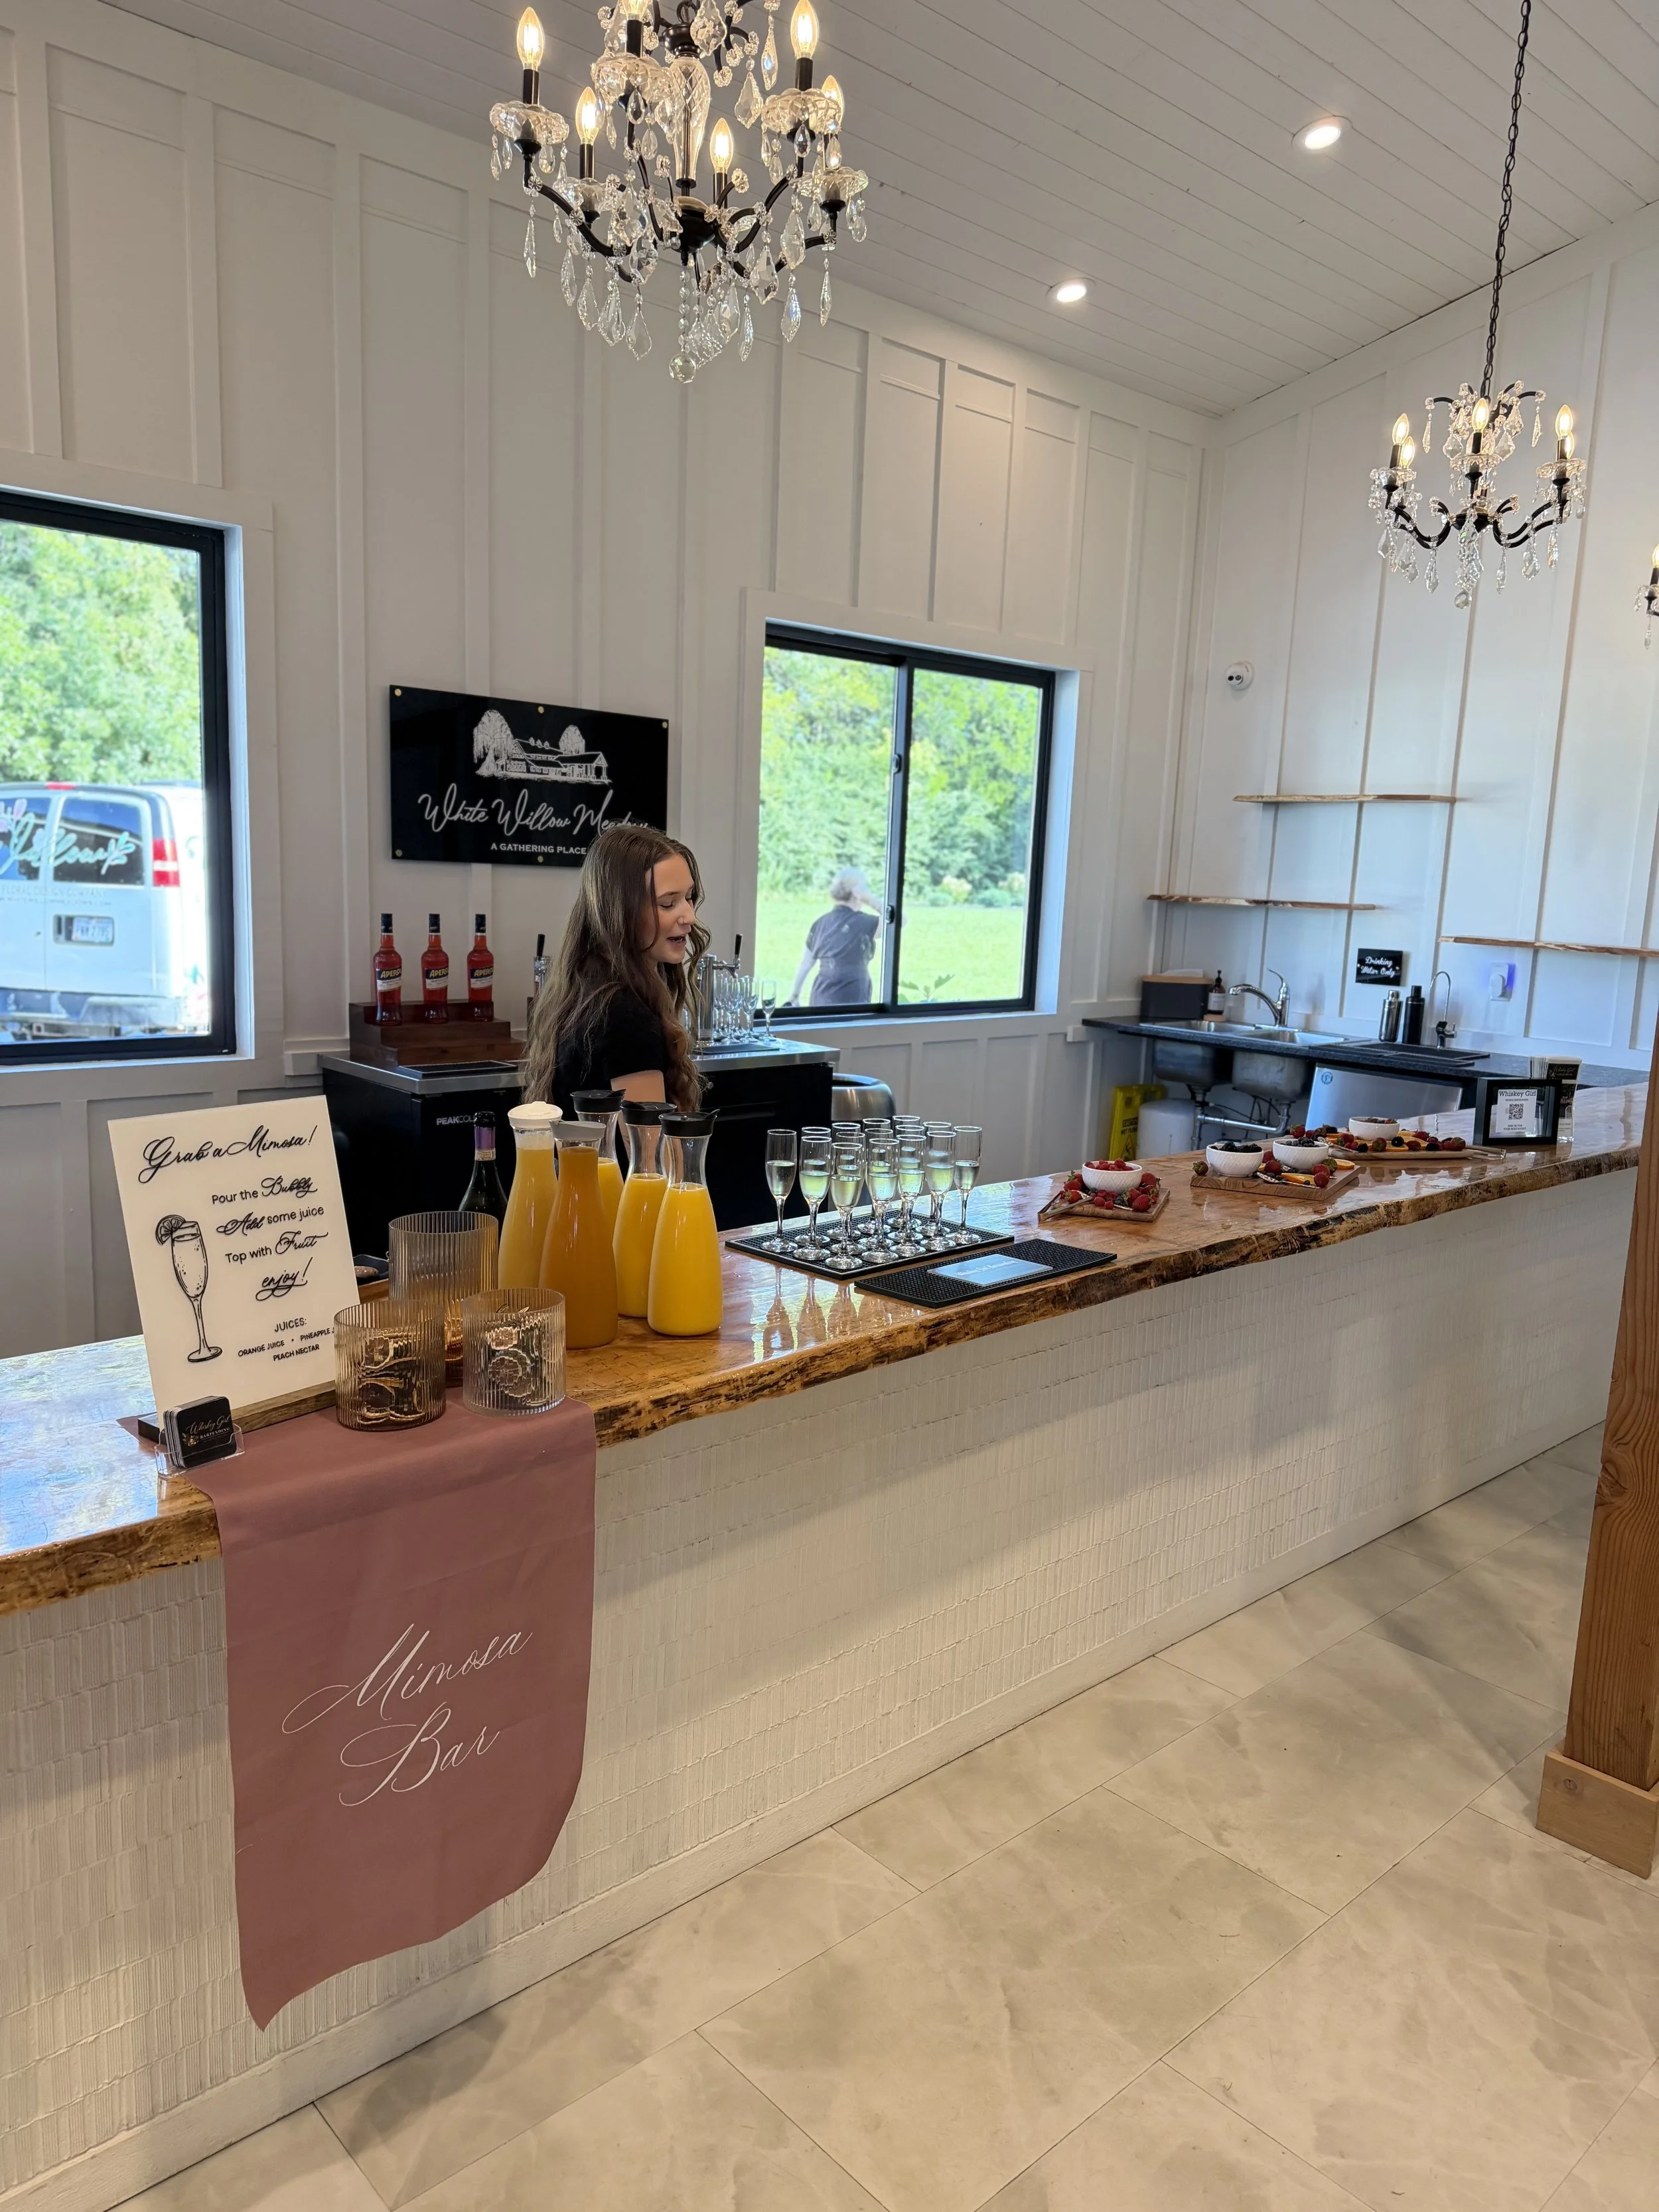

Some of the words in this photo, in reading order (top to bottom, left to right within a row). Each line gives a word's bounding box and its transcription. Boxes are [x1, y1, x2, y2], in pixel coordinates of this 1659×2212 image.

[417, 782, 489, 833] White
[491, 788, 571, 836] Willow
[500, 844, 554, 853] GATHERING
[557, 846, 587, 855] PLACE
[1360, 966, 1378, 975] Water
[1380, 967, 1396, 978] Only
[1365, 956, 1393, 968] Drinking
[436, 1114, 474, 1126] PEAKCOL
[138, 1136, 213, 1184] Grab
[212, 1148, 228, 1157] a
[226, 1125, 318, 1157] Mimosa!
[212, 1193, 238, 1205] Pour
[240, 1189, 259, 1200] the
[261, 1175, 318, 1198] Bubbly
[216, 1212, 265, 1236] Add
[267, 1213, 297, 1224] some
[298, 1205, 325, 1222] juice
[225, 1252, 247, 1264] Top
[249, 1246, 273, 1258] with
[275, 1230, 329, 1254] Fruit
[255, 1257, 313, 1301] enjoy!
[274, 1317, 307, 1333] JUICES:
[238, 1344, 265, 1357] ORANGE
[267, 1340, 285, 1350] JUICE
[300, 1327, 330, 1341] PINEAPPLE
[273, 1350, 295, 1361] PEACH
[295, 1343, 320, 1356] NECTAR
[200, 1427, 230, 1439] BARTENDING
[216, 1414, 231, 1429] Girl
[282, 1623, 533, 1734] Mimosa
[339, 1701, 500, 1806] Bar
